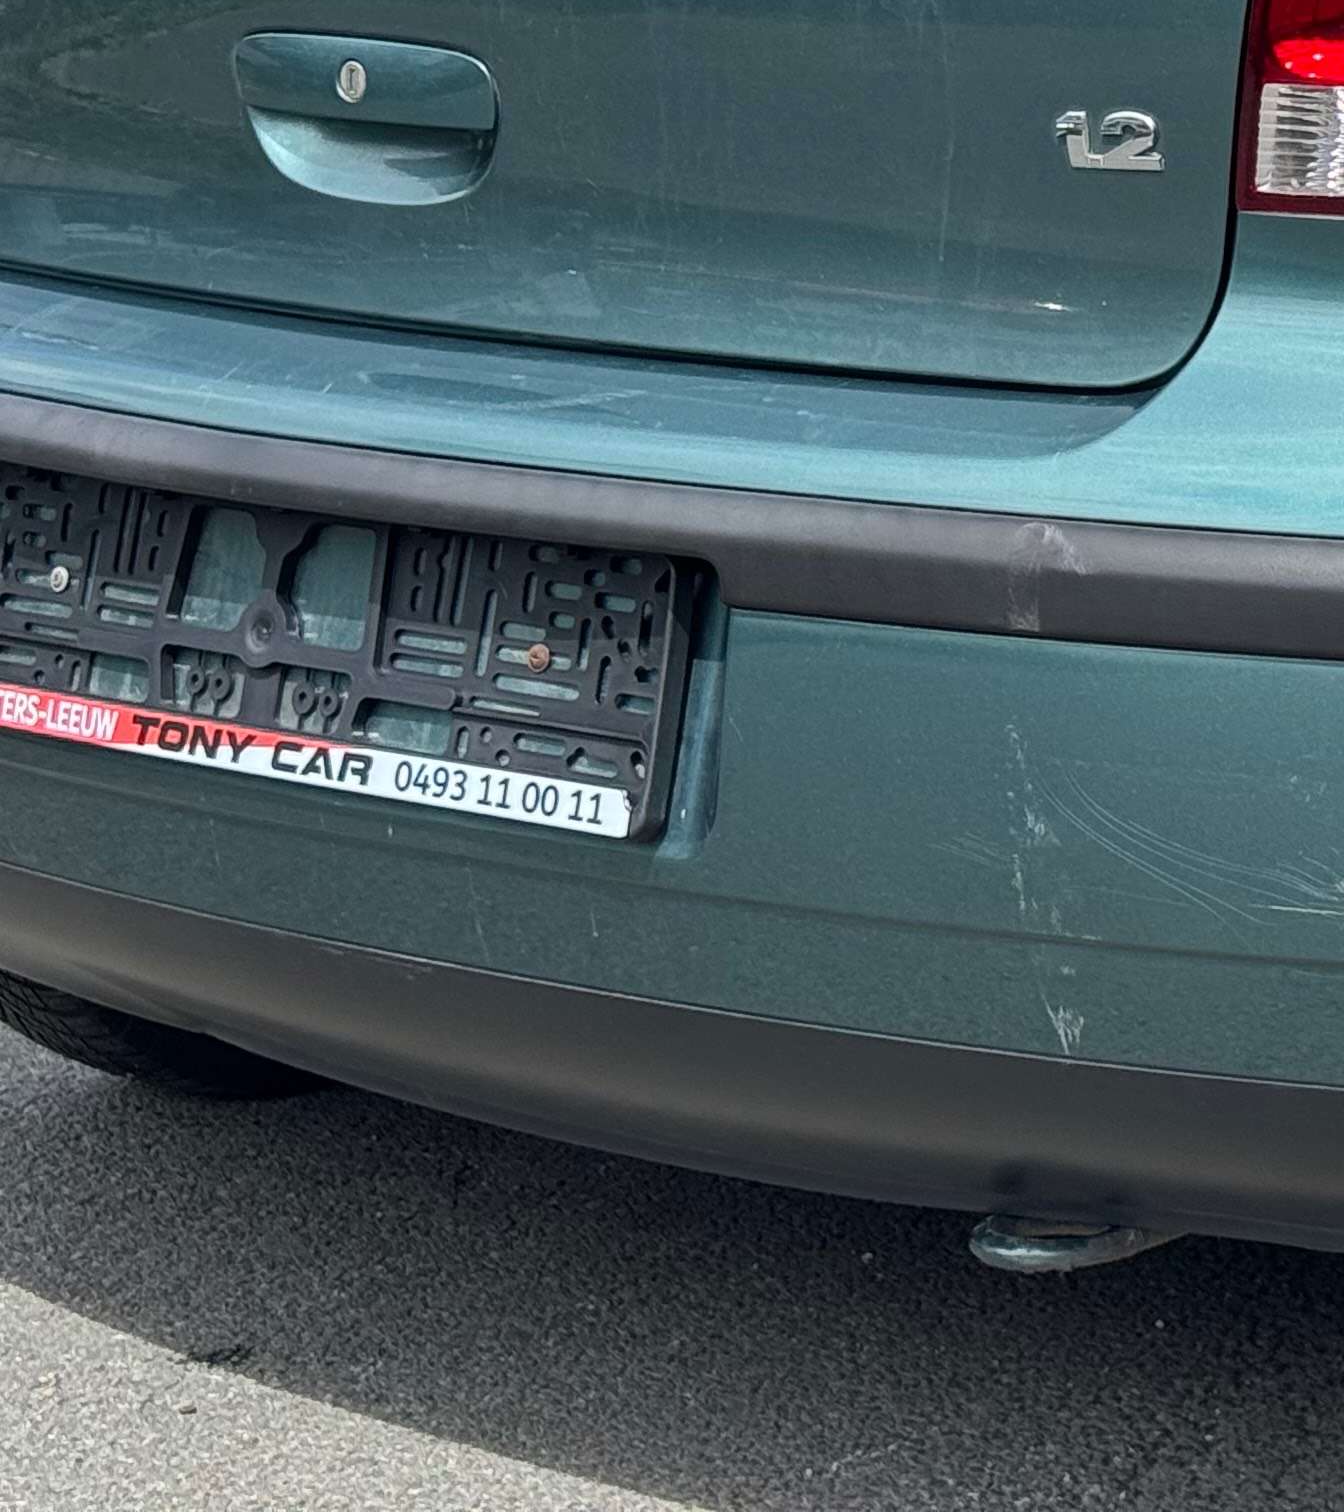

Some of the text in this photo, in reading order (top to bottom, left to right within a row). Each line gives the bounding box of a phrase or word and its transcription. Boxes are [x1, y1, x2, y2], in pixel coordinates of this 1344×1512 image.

[0, 690, 604, 826] ERS-LEEUW TONY CAR 0493 11 00 11
